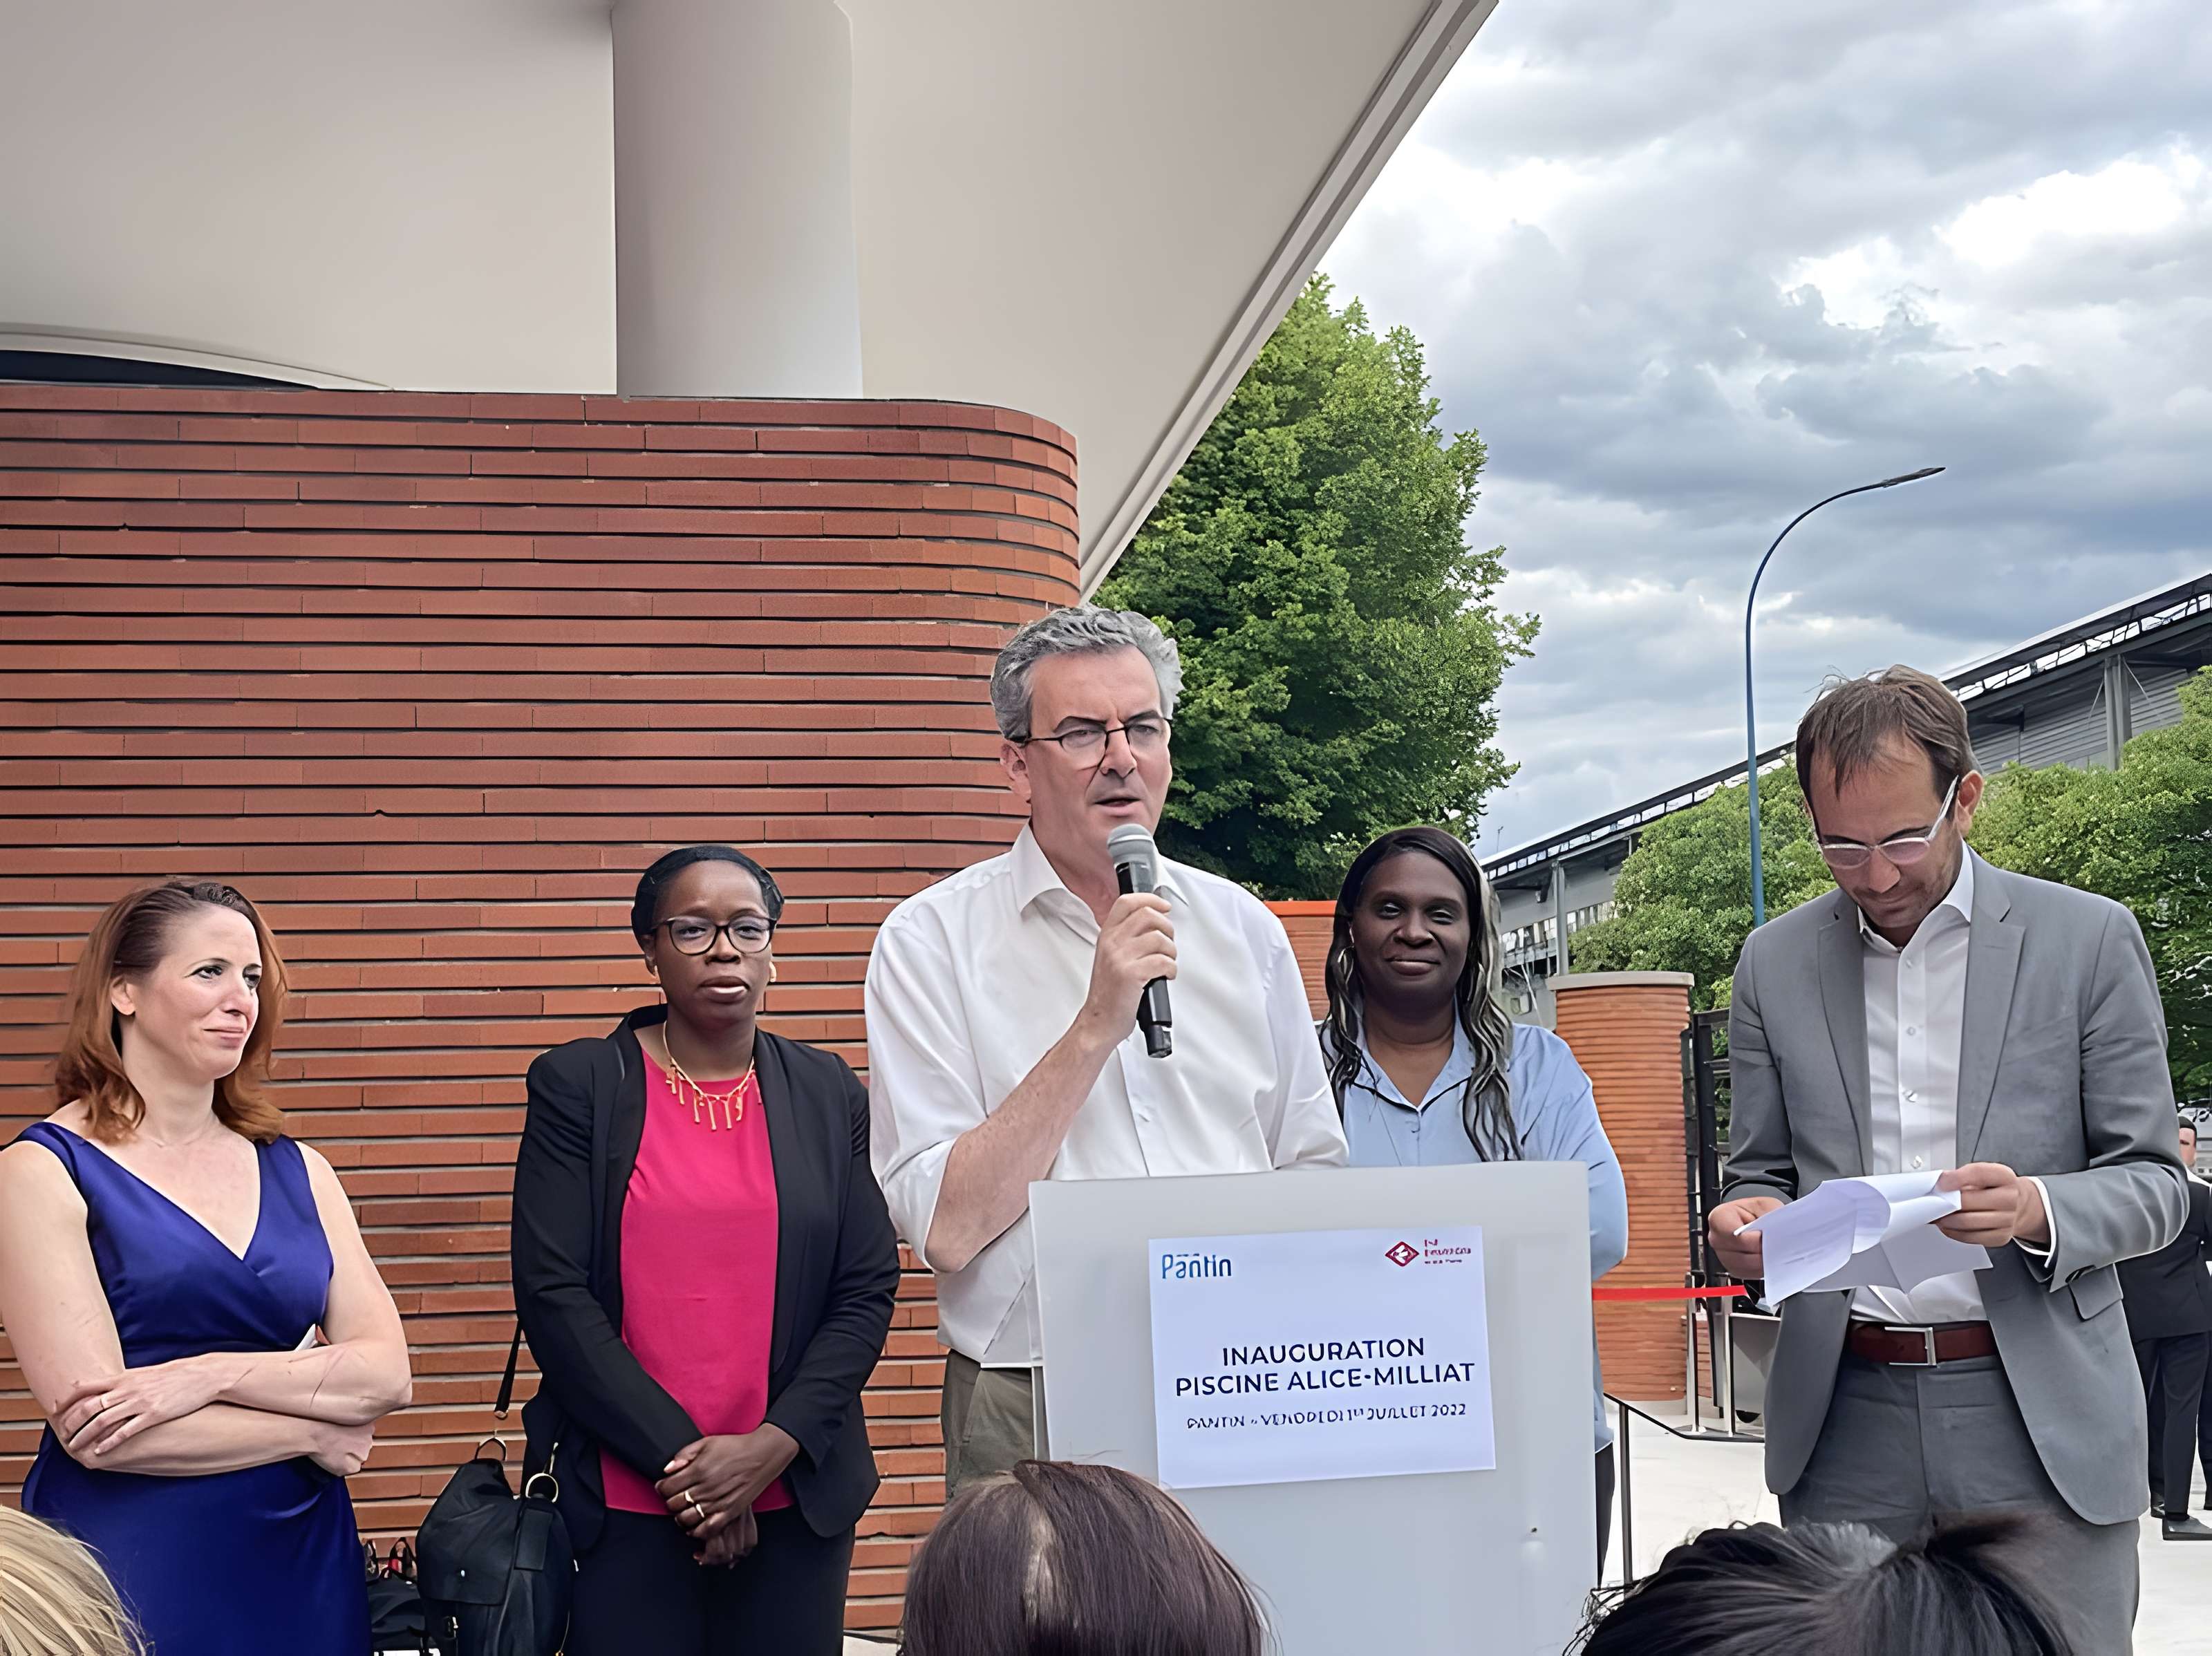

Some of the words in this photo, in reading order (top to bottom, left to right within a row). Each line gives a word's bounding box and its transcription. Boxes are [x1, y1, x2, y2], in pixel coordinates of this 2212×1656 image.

[1223, 1338, 1425, 1366] INAUGURATION
[1176, 1373, 1279, 1396] PISCINE
[1288, 1363, 1475, 1391] ALICE-MILLIAT
[1431, 1403, 1466, 1417] 2022
